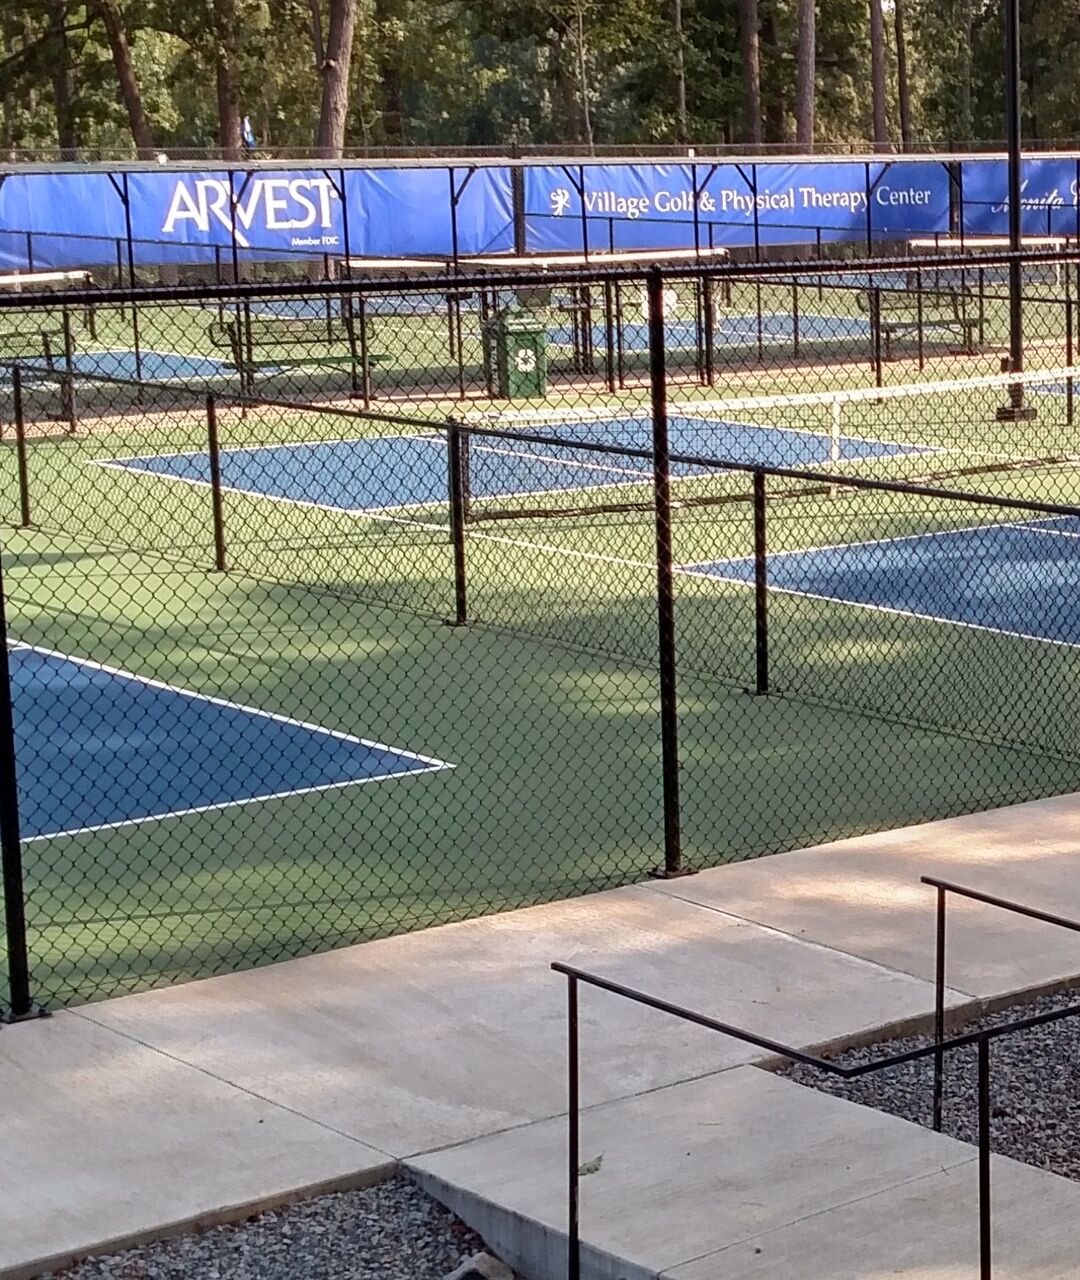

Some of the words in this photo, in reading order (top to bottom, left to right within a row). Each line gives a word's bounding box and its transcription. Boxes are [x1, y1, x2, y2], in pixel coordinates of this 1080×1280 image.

[161, 178, 336, 247] ARVEST
[583, 190, 650, 219] Village
[654, 190, 696, 212] Golf
[699, 191, 716, 212] &
[721, 187, 795, 216] Physical
[799, 187, 868, 213] Therapy
[876, 185, 932, 206] Center
[291, 235, 321, 247] Member
[321, 235, 340, 246] FDIC
